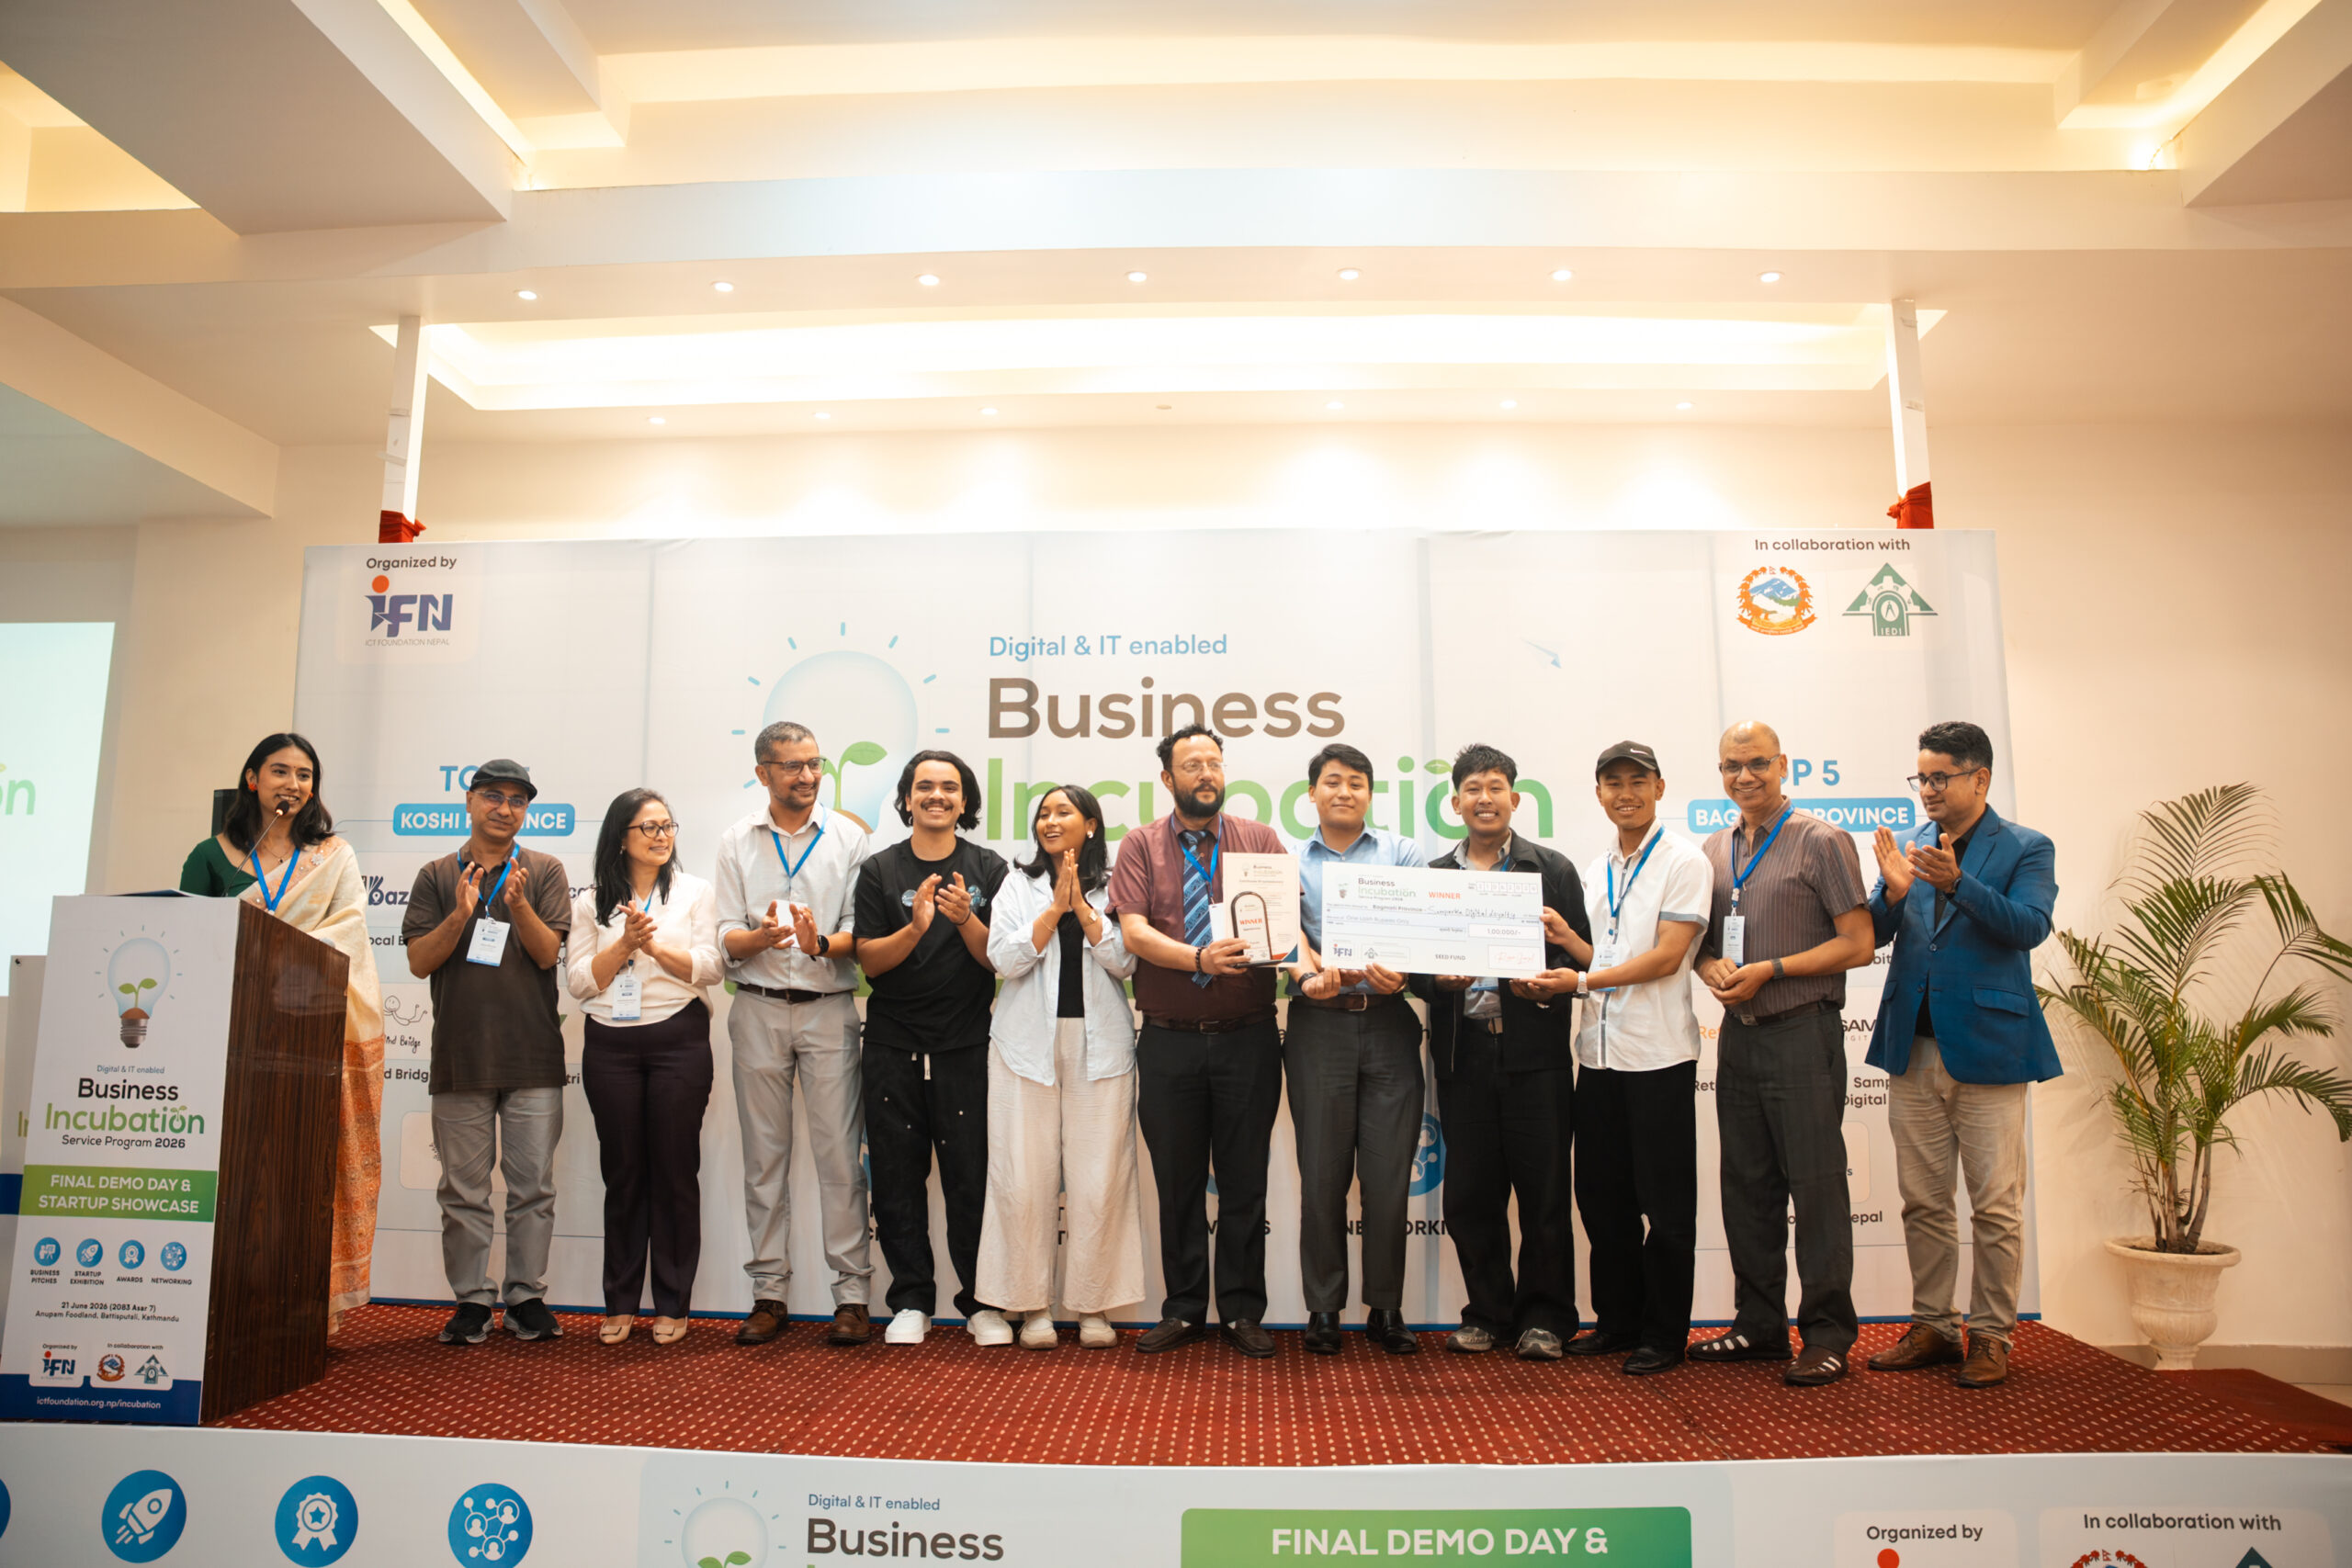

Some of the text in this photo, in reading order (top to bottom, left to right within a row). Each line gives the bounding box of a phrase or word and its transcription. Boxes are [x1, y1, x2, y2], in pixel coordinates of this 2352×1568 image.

[1755, 538, 1910, 550] In collaboration with
[366, 556, 457, 570] Organized by
[1881, 627, 1902, 636] IEDI
[378, 638, 424, 647] FOUNDATION
[989, 634, 1227, 662] Digital & IT enabled
[988, 676, 1345, 739] Business
[1822, 760, 1840, 785] 5
[401, 812, 459, 829] KOSHI
[1358, 877, 1396, 887] Business
[1358, 886, 1417, 897] Incubation
[96, 1065, 120, 1075] Digital
[395, 1068, 429, 1083] Bridg
[77, 1077, 179, 1100] Business
[45, 1102, 205, 1134] Incubation
[62, 1134, 186, 1150] Service Program 2026
[51, 1174, 191, 1192] FINAL DEMO DAY &
[38, 1195, 199, 1213] STARTUP SHOWCASE
[1850, 1210, 1883, 1225] epal
[151, 1277, 193, 1285] NETWORKING
[71, 1302, 88, 1310] June
[109, 1303, 130, 1312] (2083
[131, 1303, 148, 1312] Asar
[149, 1304, 156, 1313] 7)
[35, 1310, 63, 1319] Anupam
[141, 1314, 179, 1323] Kathmandu
[36, 1396, 162, 1409] ictfoundation.org.np/incubation
[808, 1494, 941, 1510] Digital & IT enabled
[2084, 1513, 2282, 1531] In collaboration with
[807, 1517, 1004, 1562] Business
[1272, 1527, 1609, 1555] FINAL DEMO DAY &
[1866, 1524, 1984, 1542] Organized by
